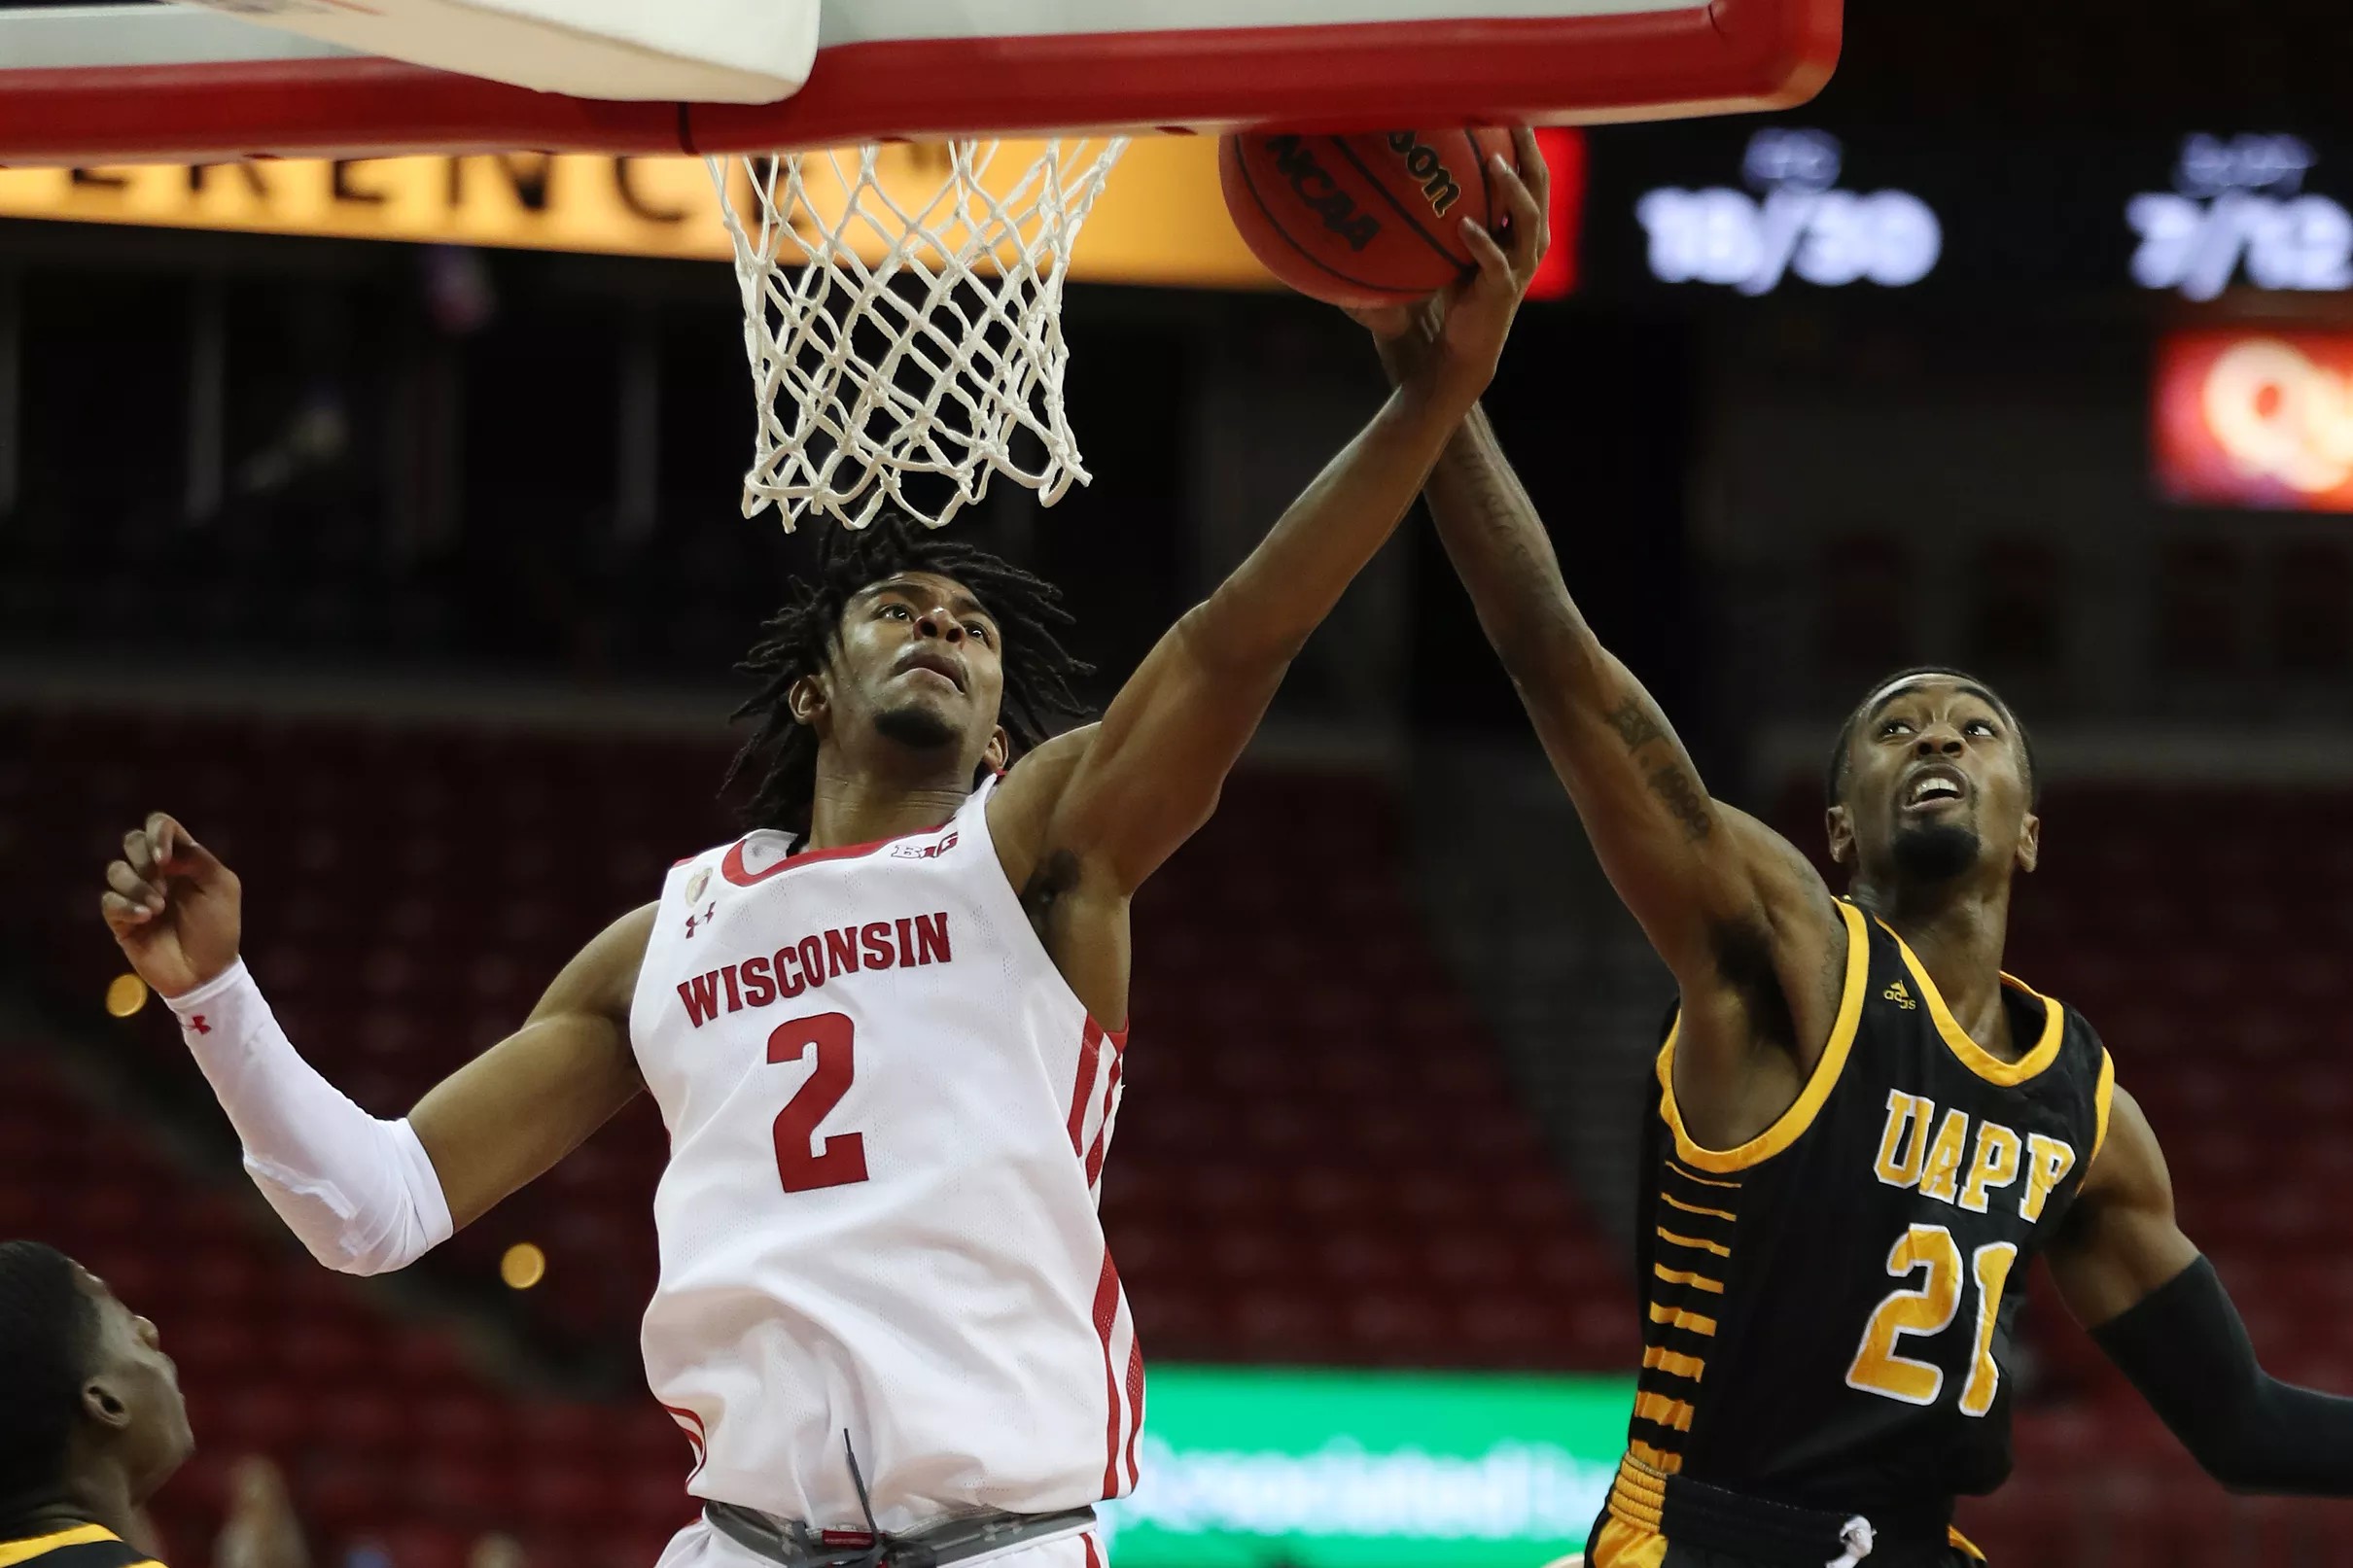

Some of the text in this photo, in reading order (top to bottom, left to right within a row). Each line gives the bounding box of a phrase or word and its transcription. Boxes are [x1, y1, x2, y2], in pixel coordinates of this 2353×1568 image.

[677, 912, 951, 1028] WISCONSIN
[766, 1012, 869, 1194] 2
[1845, 1223, 2019, 1417] 21
